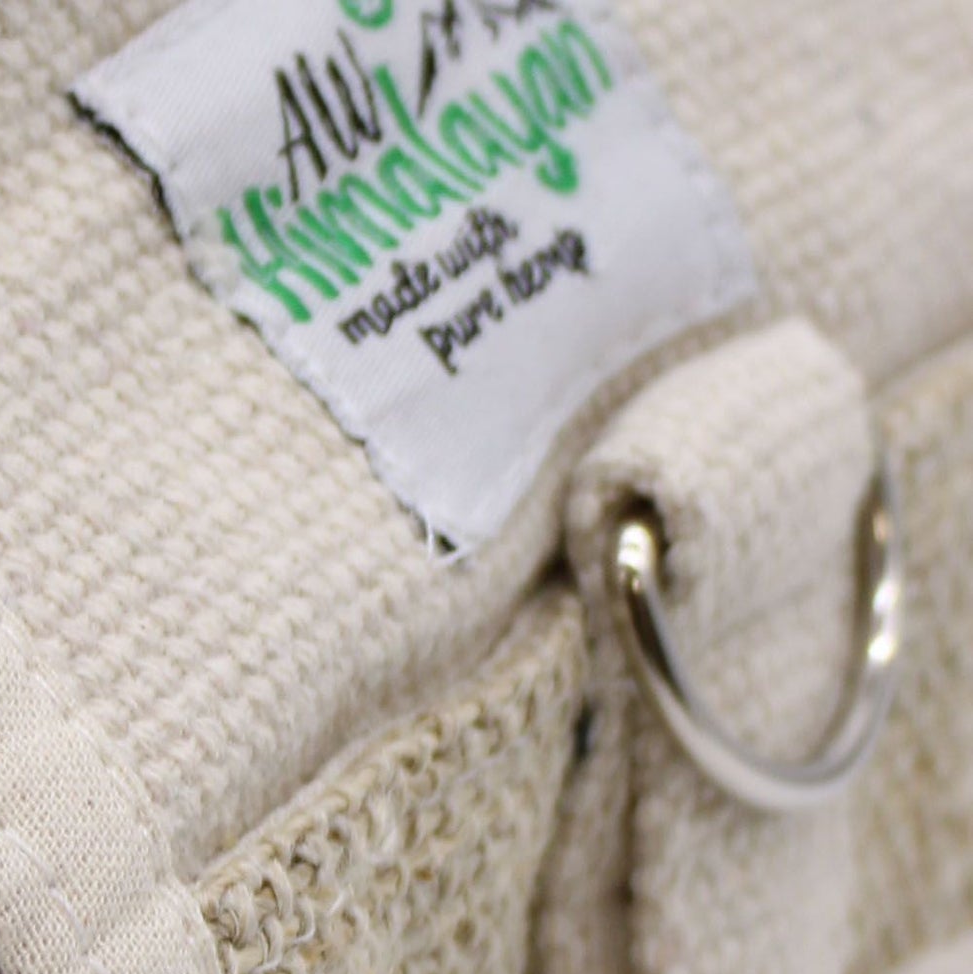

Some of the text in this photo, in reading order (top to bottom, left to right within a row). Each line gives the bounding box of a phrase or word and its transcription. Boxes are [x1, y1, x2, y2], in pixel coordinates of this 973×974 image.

[217, 19, 615, 323] Himalayan
[338, 208, 519, 346] made with
[419, 227, 590, 376] pure hemp
